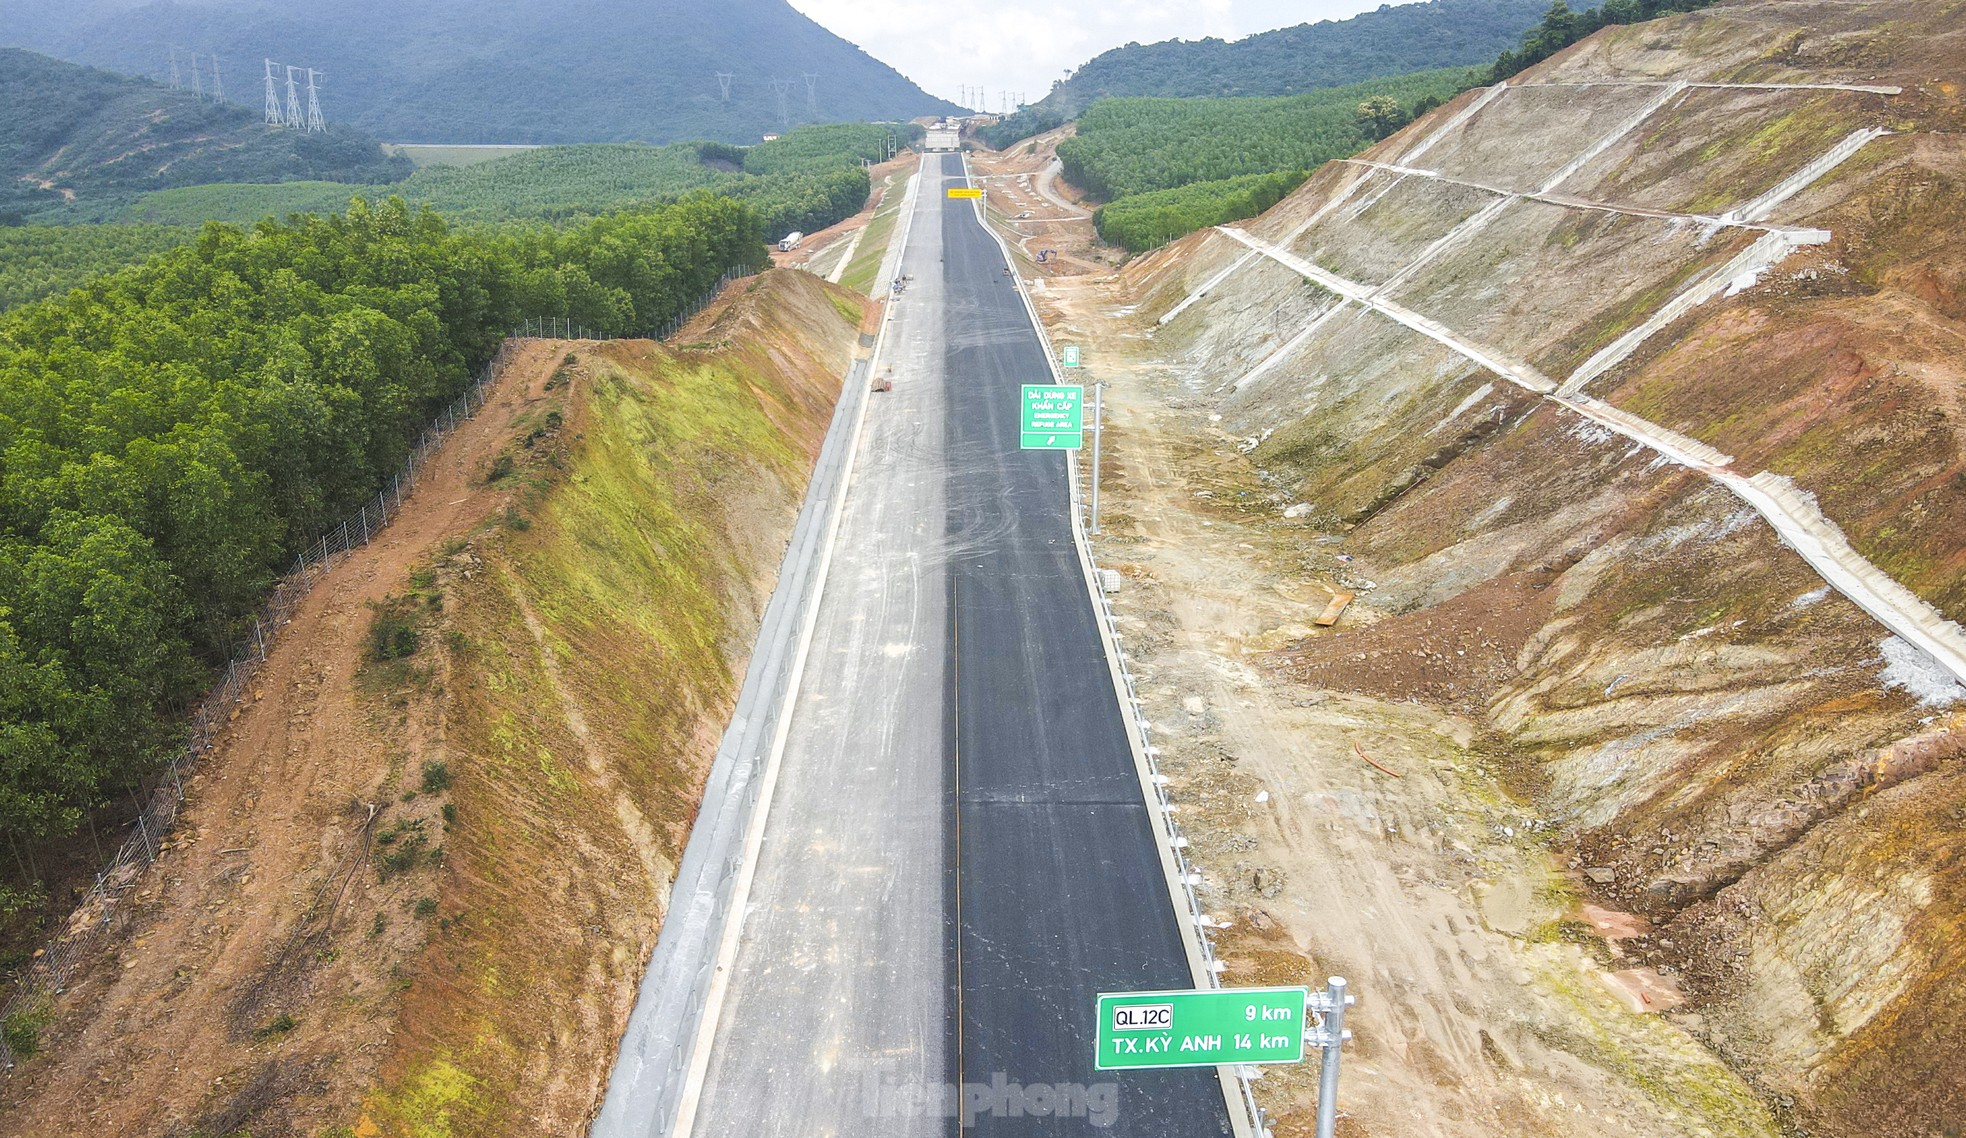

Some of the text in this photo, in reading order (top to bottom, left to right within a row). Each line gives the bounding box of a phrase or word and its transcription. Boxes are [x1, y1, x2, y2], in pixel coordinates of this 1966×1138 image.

[1067, 392, 1077, 400] XE
[1116, 1010, 1170, 1025] QL.12C
[1245, 1005, 1291, 1020] 9 km
[1112, 1032, 1289, 1054] TX.KỲ ANH 14 km
